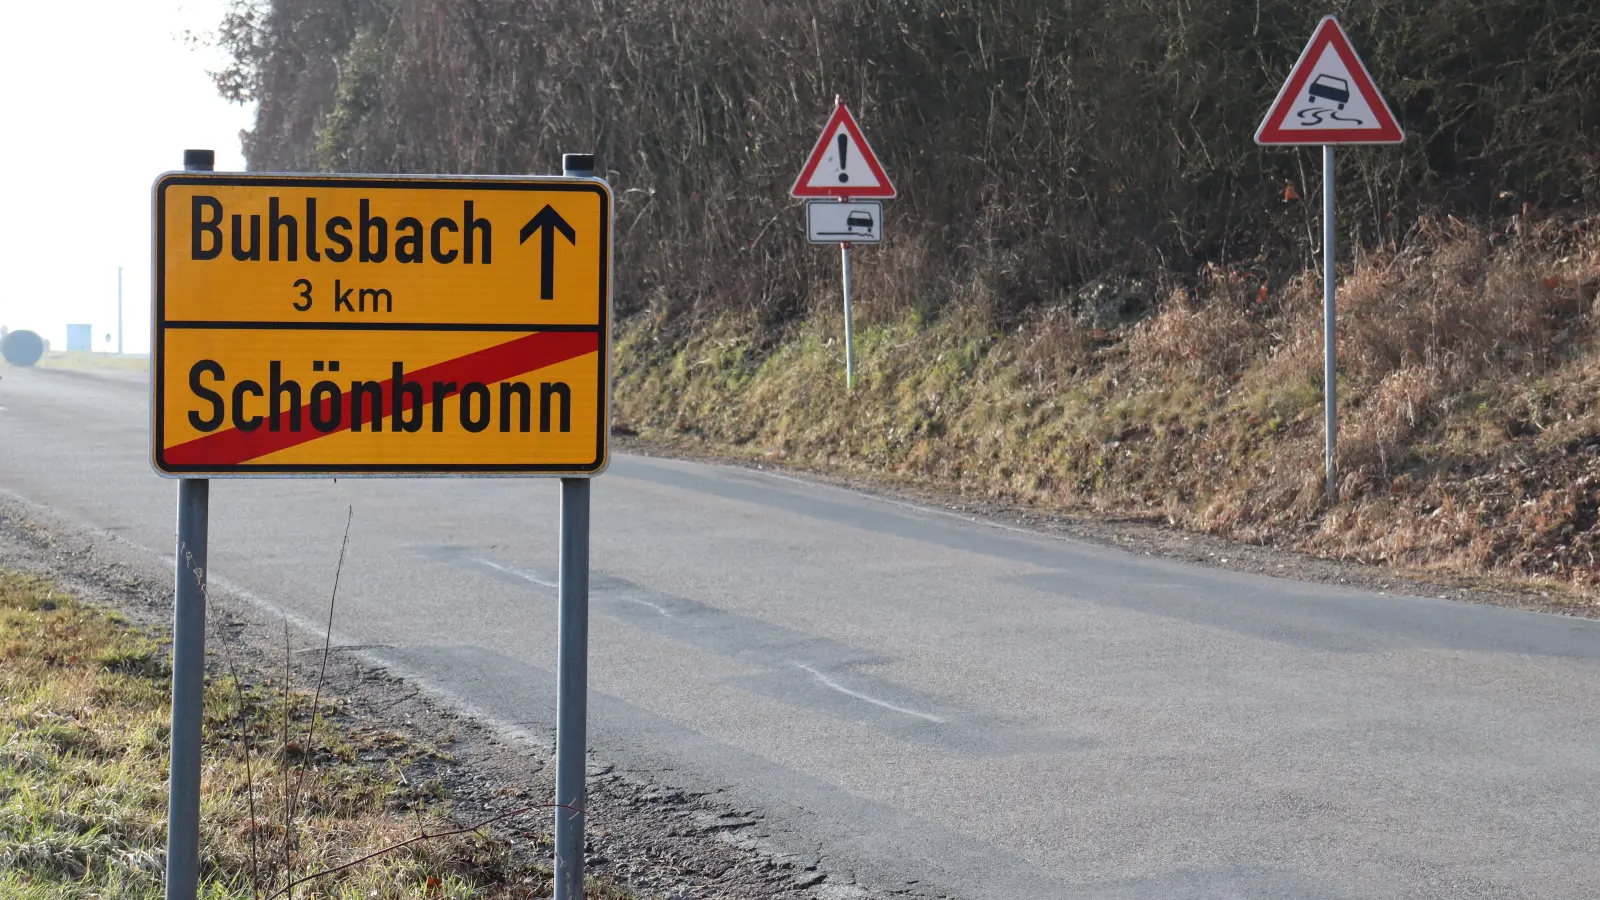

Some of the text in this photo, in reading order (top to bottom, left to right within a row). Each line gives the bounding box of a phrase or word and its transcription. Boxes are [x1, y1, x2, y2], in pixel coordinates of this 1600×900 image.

[191, 195, 492, 265] Buhlsbach
[292, 278, 392, 313] 3 km
[187, 359, 571, 433] Schönbronn
